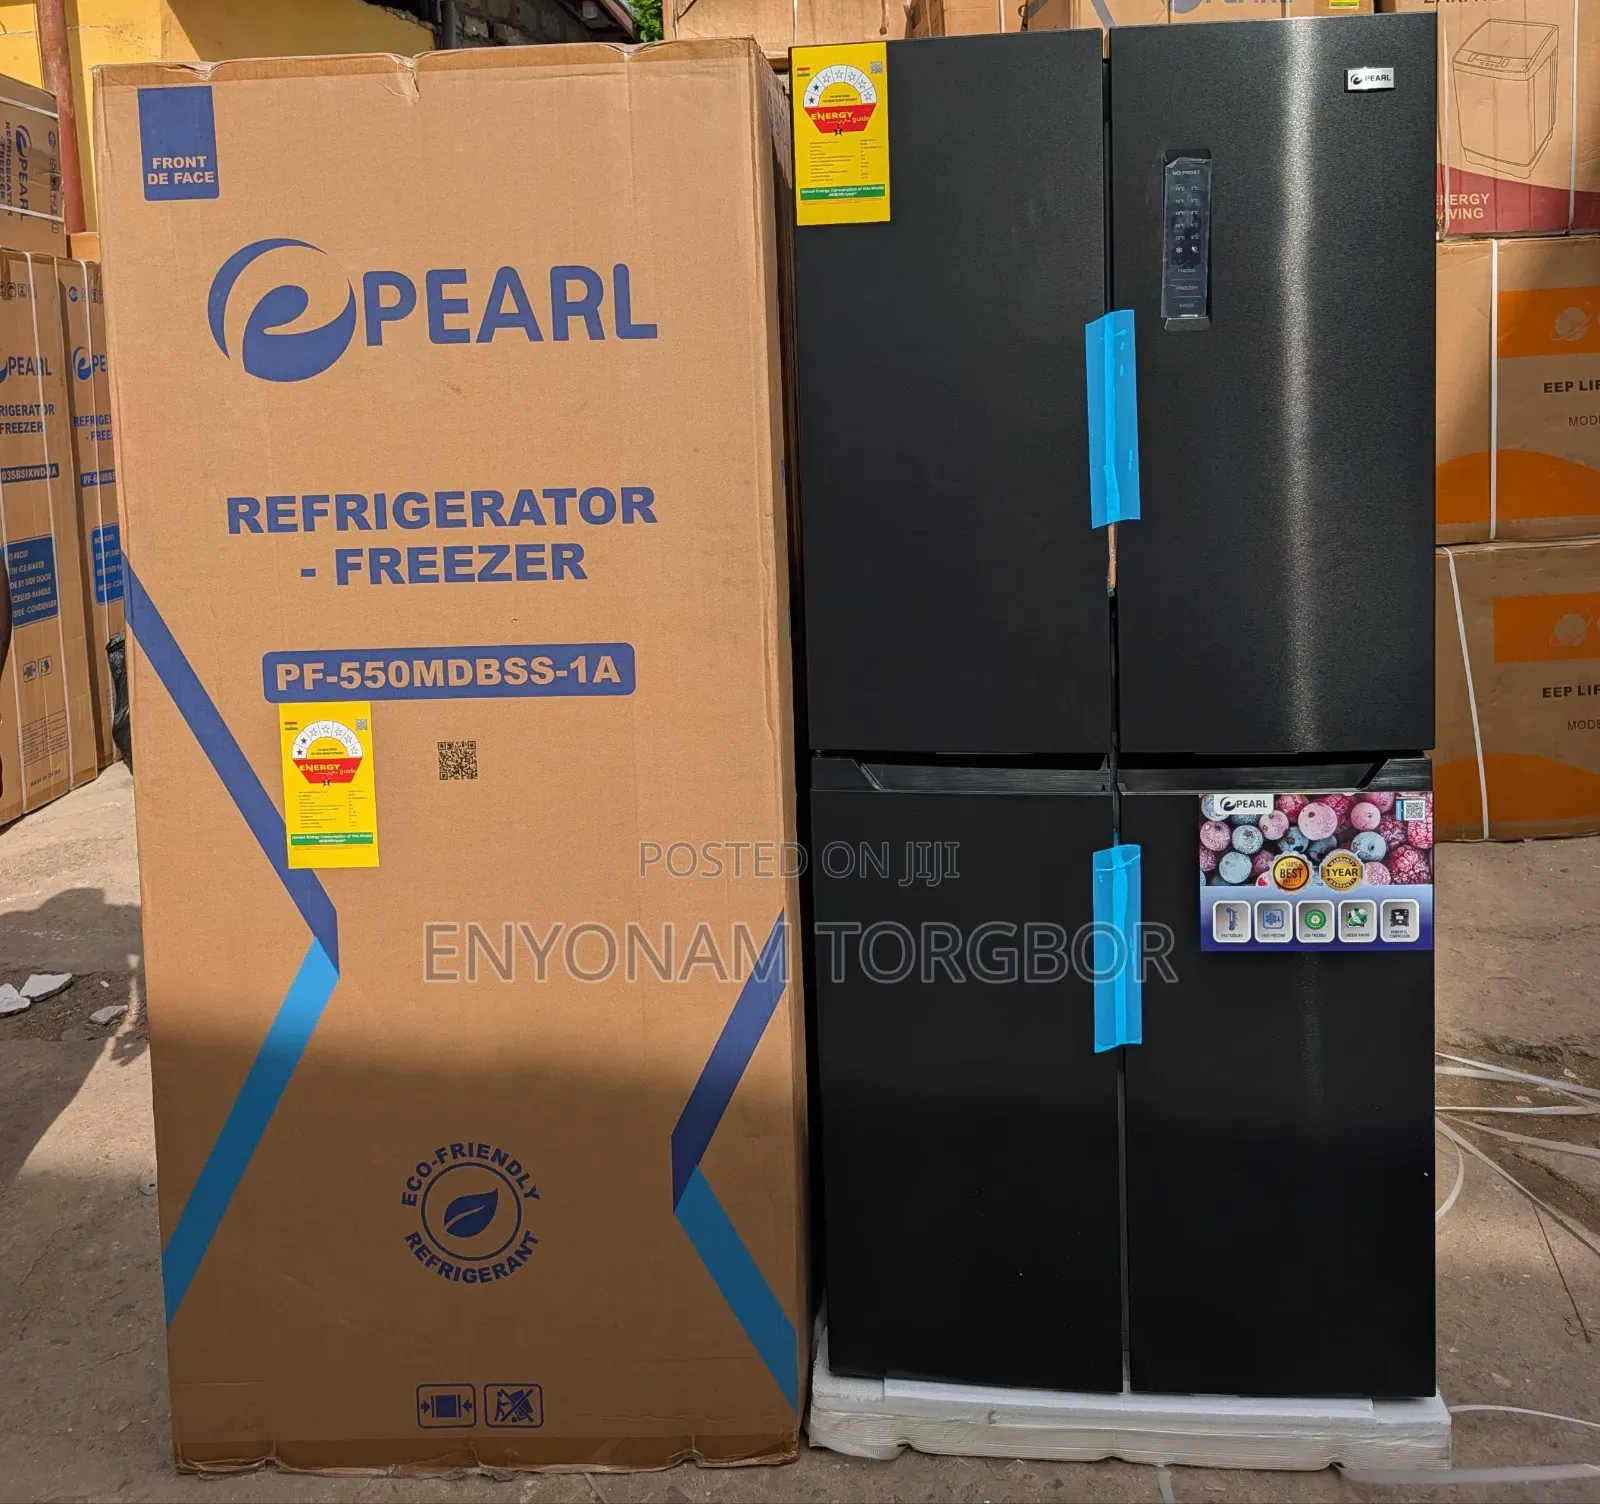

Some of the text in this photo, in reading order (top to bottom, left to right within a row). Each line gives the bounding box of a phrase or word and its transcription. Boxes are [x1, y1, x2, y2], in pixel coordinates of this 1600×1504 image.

[1364, 74, 1392, 82] PEARL
[811, 111, 870, 124] ENERGY guide
[5, 121, 13, 217] REFRIGERATOR
[152, 155, 208, 170] FRONT
[147, 171, 216, 185] DE FACE
[18, 157, 29, 221] PEARL
[362, 263, 658, 346] PEARL
[8, 356, 52, 376] PEARL
[1543, 381, 1574, 394] EEP
[227, 486, 658, 535] REFRIGERATOR
[334, 543, 588, 586] FREEZER
[36, 573, 52, 583] DOOR
[276, 655, 622, 691] PF-550MDBSS-1A
[1542, 686, 1573, 698] EEP
[299, 763, 341, 773] ENERGY
[1236, 799, 1268, 809] PEARL
[1280, 868, 1303, 879] BEST
[1325, 868, 1359, 877] 1 YEAR
[401, 1142, 541, 1207] ECO-FRIENDLY
[404, 1230, 539, 1284] REFRIGERANT
